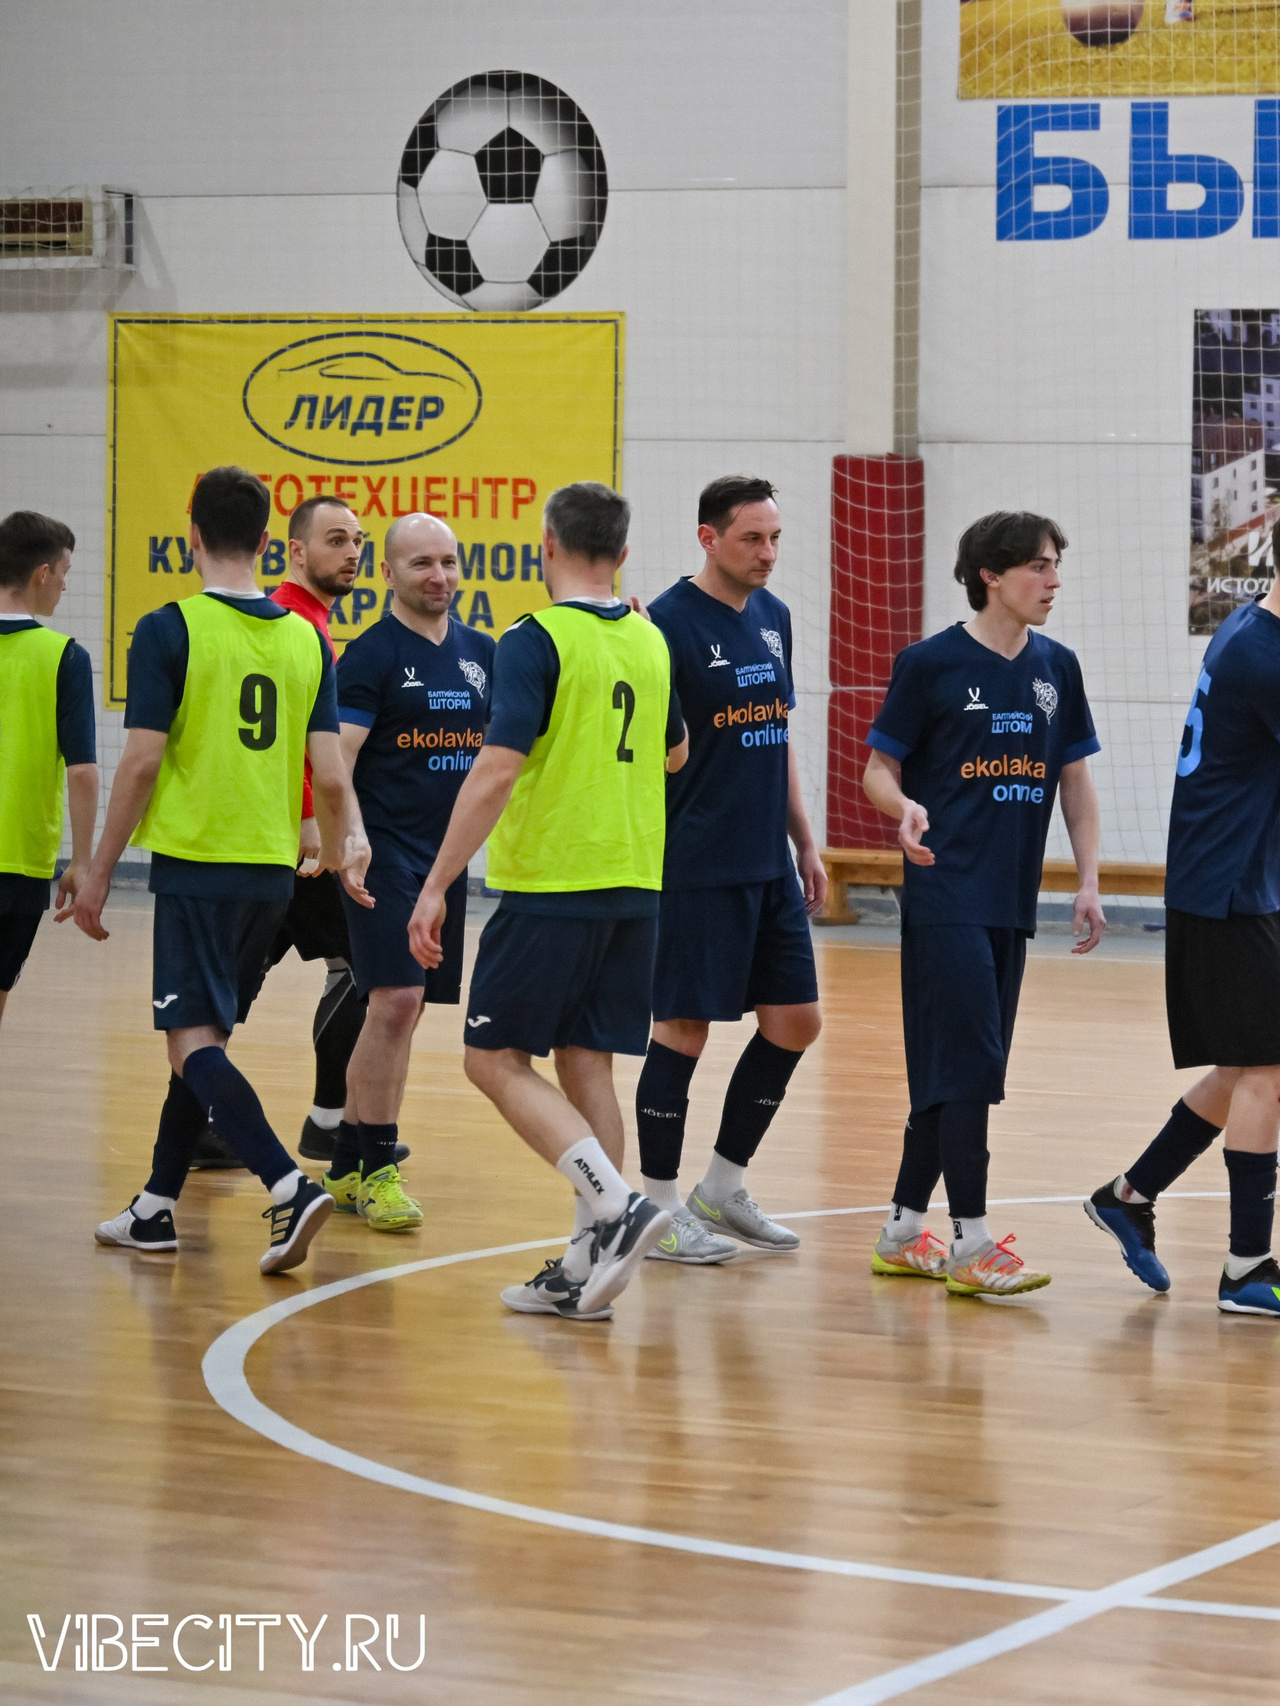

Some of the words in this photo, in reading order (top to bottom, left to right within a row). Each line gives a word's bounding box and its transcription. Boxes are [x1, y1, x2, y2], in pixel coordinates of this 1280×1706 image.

[284, 394, 446, 437] ЛИДЕР
[186, 473, 538, 520] ОТЕХЦЕНТР
[736, 670, 777, 688] ШТОРМ
[427, 690, 471, 699] БАЛТИЙСКИЙ
[428, 699, 472, 711] ШТОРМ
[238, 673, 279, 752] 9
[612, 680, 636, 763] 2
[397, 727, 484, 749] ekolavka
[428, 750, 477, 772] onlin
